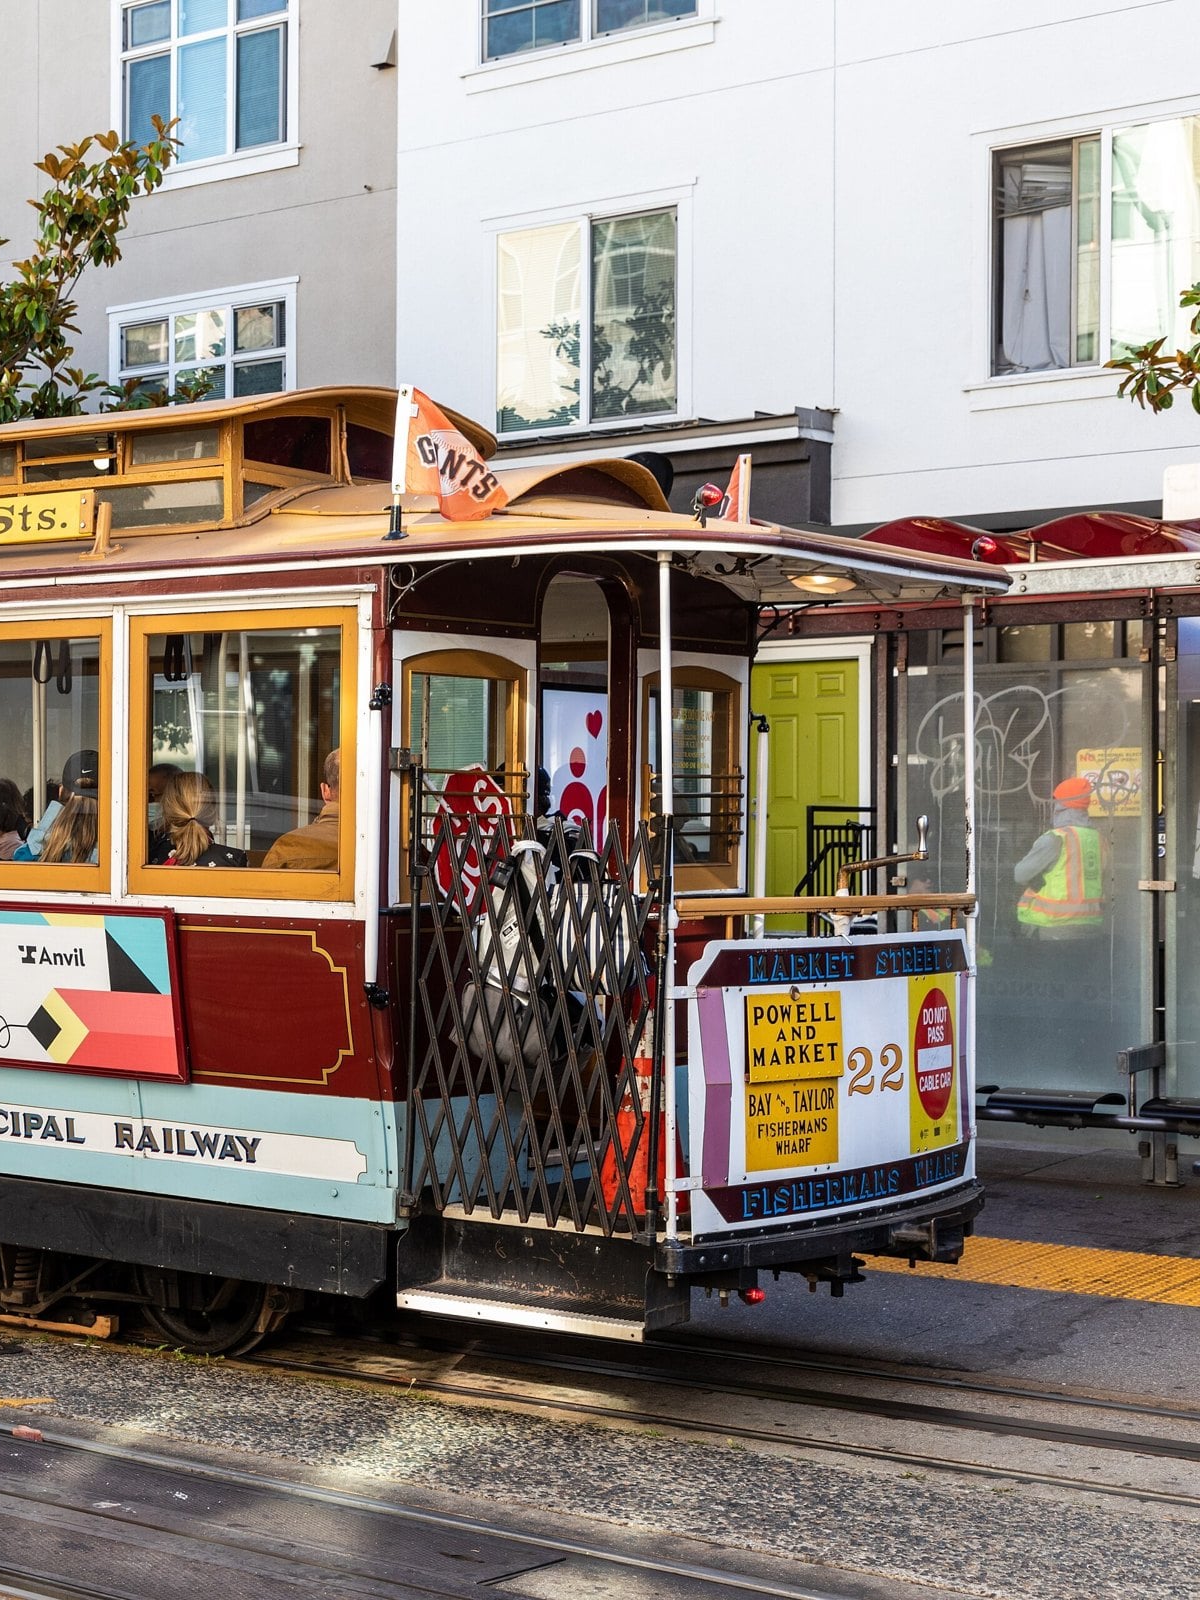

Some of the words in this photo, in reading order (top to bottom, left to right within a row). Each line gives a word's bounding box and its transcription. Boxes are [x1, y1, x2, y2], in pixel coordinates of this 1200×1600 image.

[39, 946, 85, 967] Anvil
[749, 952, 855, 983] MARKET
[875, 945, 941, 976] STREET
[753, 1002, 836, 1026] POWELL
[923, 1008, 934, 1025] DO
[934, 1006, 947, 1023] NOT
[776, 1025, 816, 1042] AND
[927, 1025, 944, 1043] PASS
[753, 1042, 838, 1067] MARKET
[847, 1043, 904, 1096] 22
[919, 1074, 940, 1093] CABLE
[940, 1071, 951, 1088] CAR
[748, 1093, 772, 1117] BAY
[793, 1088, 835, 1112] TAYLOR
[758, 1117, 828, 1139] FISHERMANS
[114, 1122, 262, 1164] RAILWAY
[776, 1137, 812, 1155] WHARF
[741, 1168, 900, 1218] FISHERMANS
